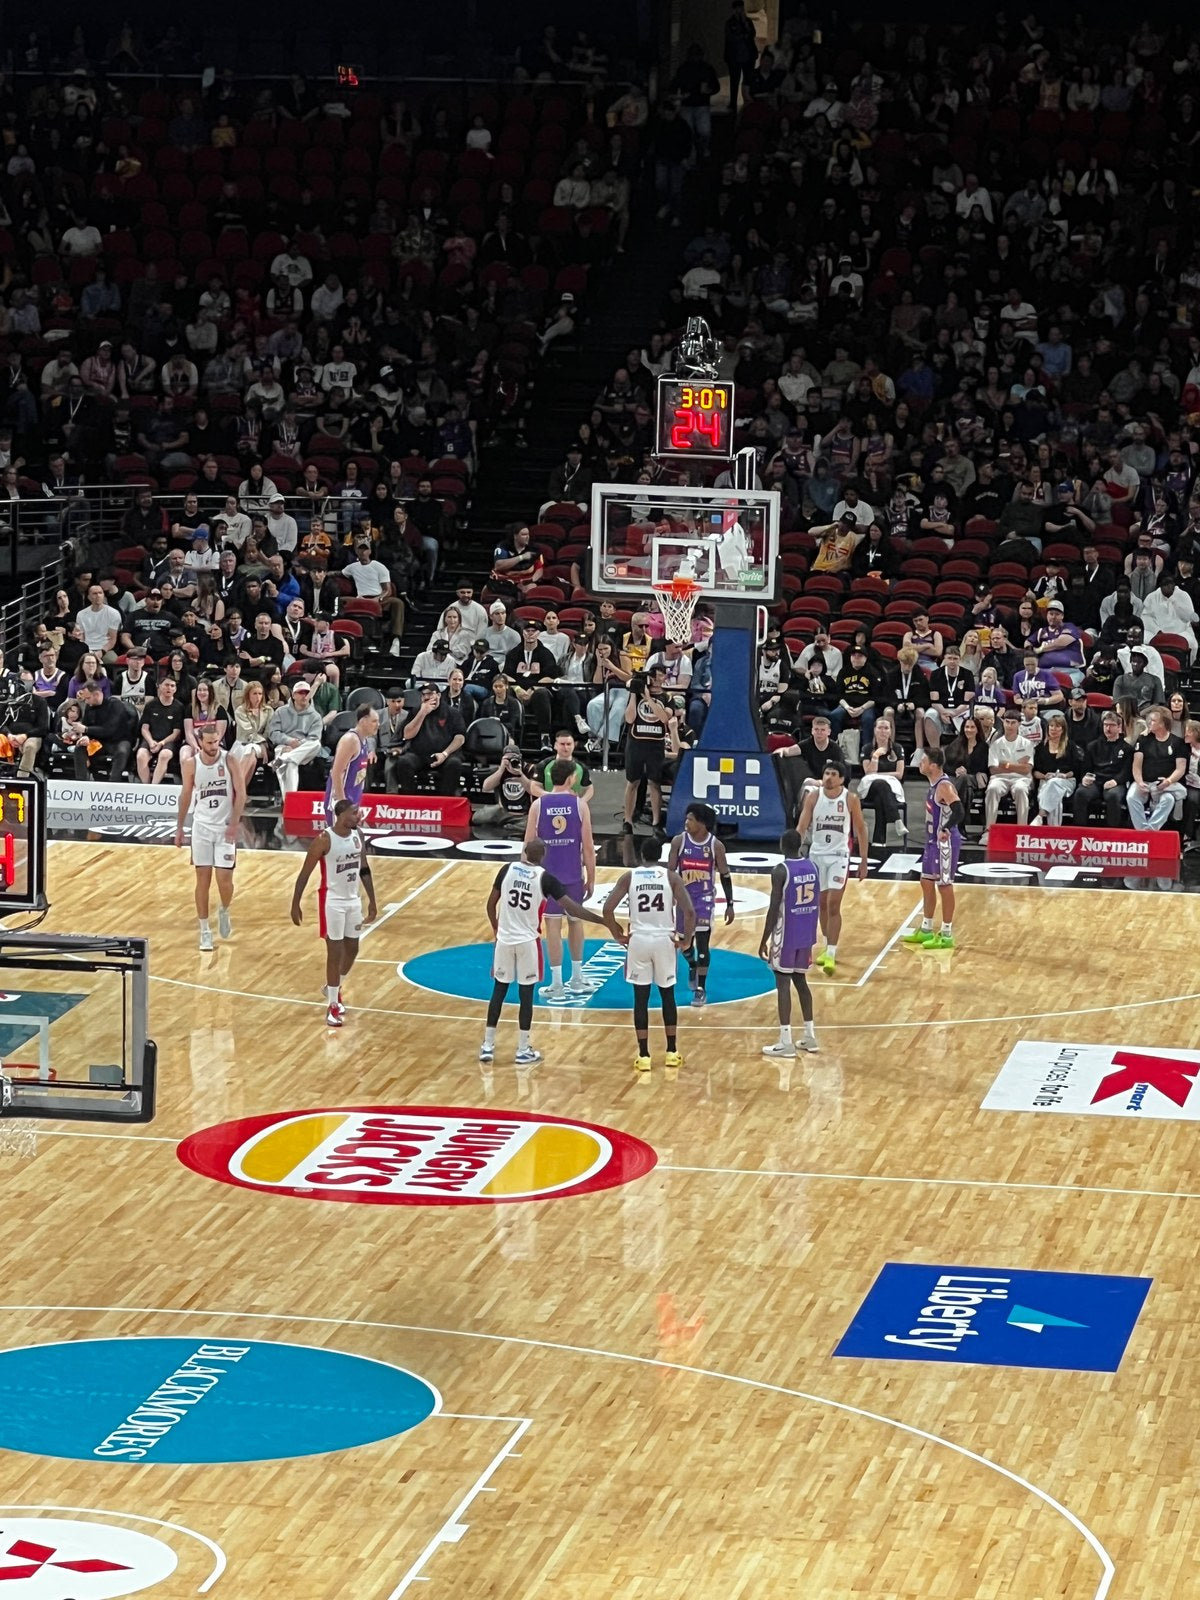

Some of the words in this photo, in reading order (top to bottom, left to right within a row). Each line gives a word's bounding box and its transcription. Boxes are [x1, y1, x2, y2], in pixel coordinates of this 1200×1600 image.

[682, 387, 727, 409] 3:07
[672, 410, 720, 448] 24
[737, 571, 763, 583] Sprite
[90, 791, 177, 807] WAREHOUS
[209, 799, 219, 808] 13
[375, 804, 442, 821] Norman
[552, 815, 567, 835] 9
[825, 834, 832, 844] 6
[1015, 834, 1078, 854] Harvey
[1081, 837, 1149, 854] Norman
[703, 880, 709, 891] 1
[795, 883, 815, 905] 15
[508, 889, 533, 911] 35
[637, 893, 665, 912] 24
[1057, 1048, 1089, 1060] Low
[1046, 1061, 1077, 1082] prices
[1039, 1084, 1070, 1095] for
[304, 1118, 446, 1187] JACK'S
[405, 1122, 521, 1192] HUNGRY
[884, 1275, 1011, 1352] Liberty
[93, 1343, 251, 1459] BLACKMORES
